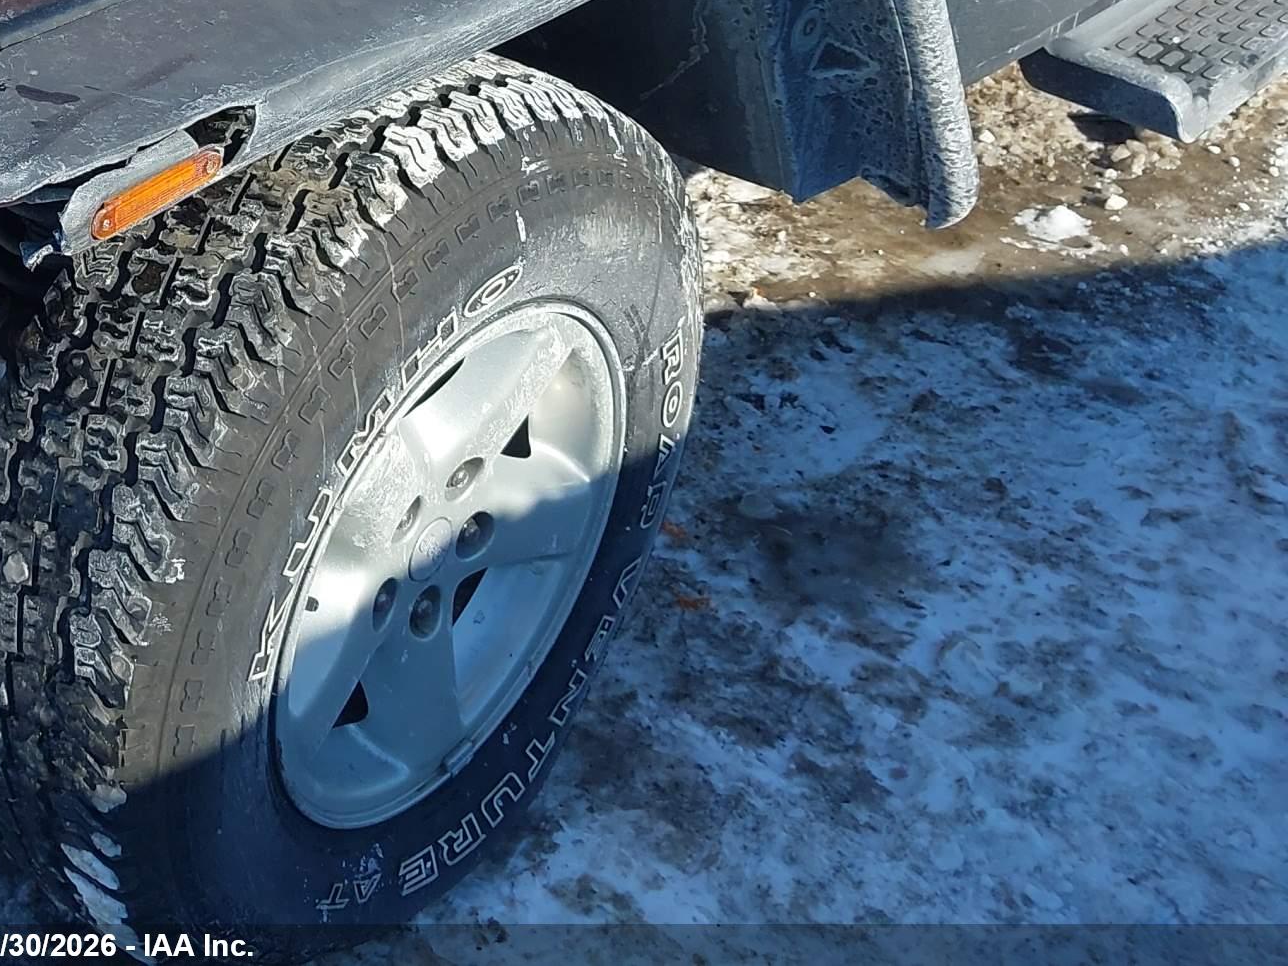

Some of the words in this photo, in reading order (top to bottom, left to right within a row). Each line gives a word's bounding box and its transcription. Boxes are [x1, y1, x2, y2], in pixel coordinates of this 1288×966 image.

[248, 264, 524, 681] KUMHO
[639, 327, 684, 529] ROAD
[398, 557, 642, 896] VENTURE
